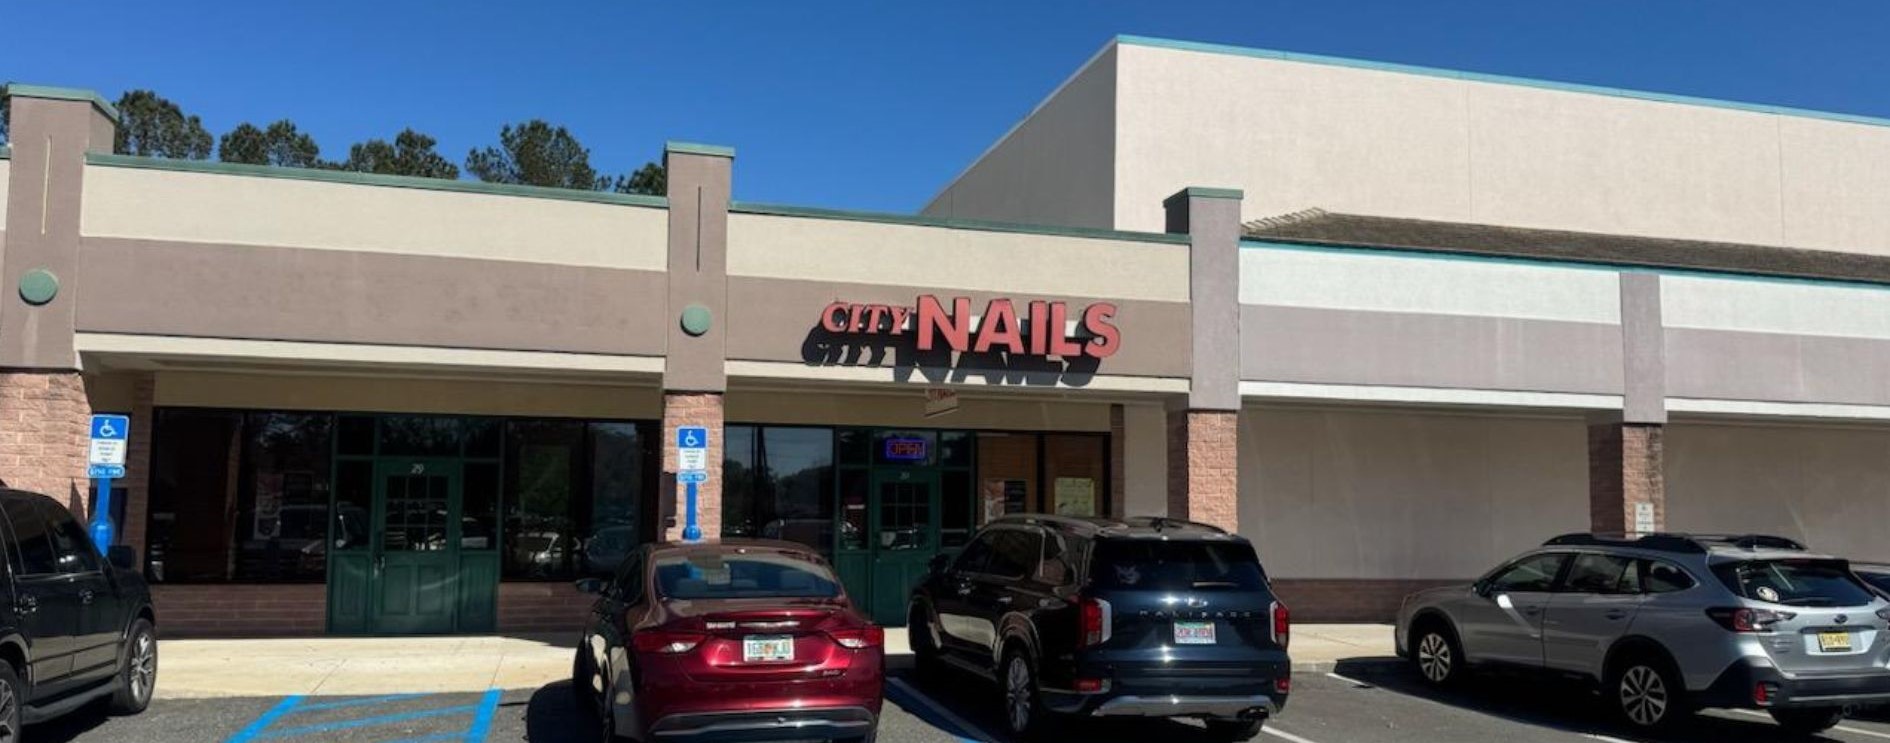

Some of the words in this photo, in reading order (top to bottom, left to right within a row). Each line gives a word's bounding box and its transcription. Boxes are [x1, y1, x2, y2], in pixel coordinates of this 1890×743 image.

[822, 301, 914, 335] CITY
[916, 294, 1121, 358] NAILS
[889, 442, 922, 456] OPEN
[410, 463, 425, 475] 29
